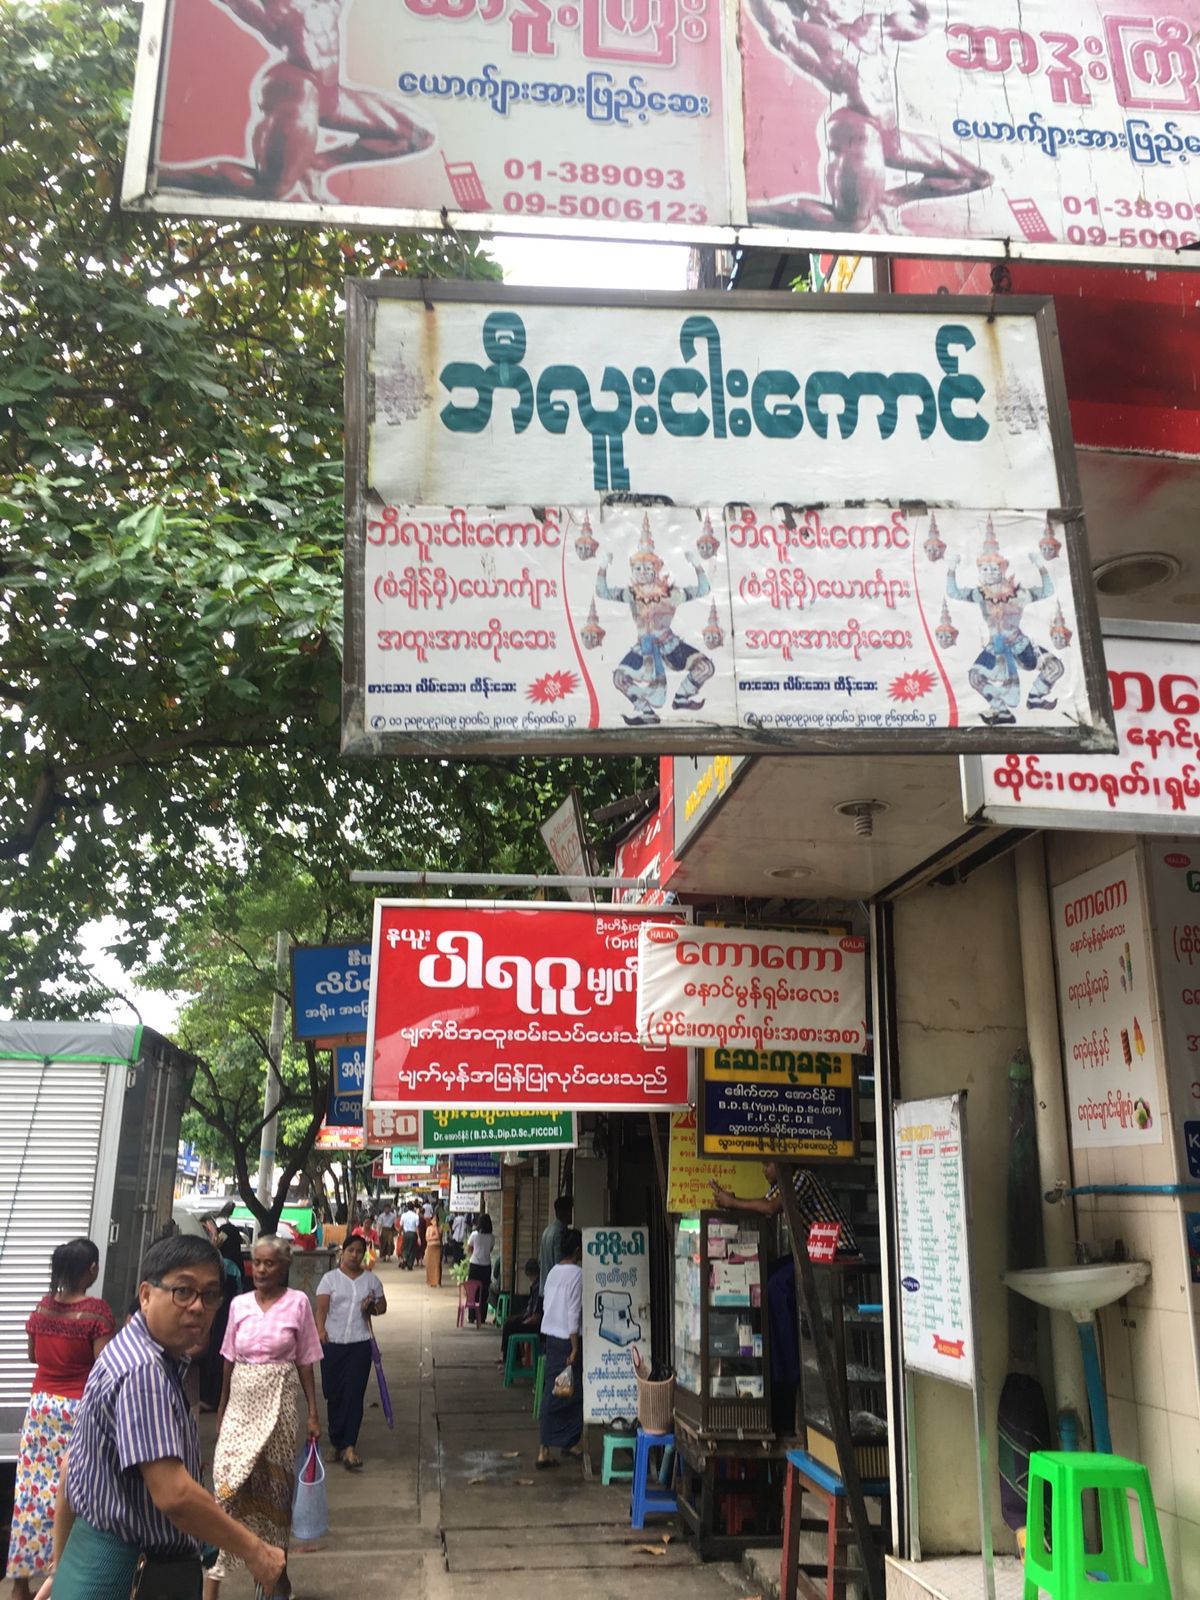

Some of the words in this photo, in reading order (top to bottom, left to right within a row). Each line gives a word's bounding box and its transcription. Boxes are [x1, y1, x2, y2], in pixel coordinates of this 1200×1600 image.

[503, 159, 686, 190] 01-389093
[503, 191, 709, 224] 09-5006123
[439, 311, 990, 491] ဘီလူးငါးကောင်
[367, 507, 560, 562] ဘီလူးငါးကောင်
[729, 510, 910, 563] ဘီလူးငါးကောင်
[377, 618, 557, 662] အထူးအားတိုးဆေး
[1065, 880, 1127, 928] ကောကော
[386, 926, 431, 949] နယူး
[650, 930, 675, 939] HALAL
[418, 930, 593, 1016] ပါရဂူ
[587, 956, 638, 1006] မျက်
[675, 941, 843, 972] ကောကော
[684, 976, 839, 1010] နောင်မွန်ရှမ်းလေး
[400, 1021, 643, 1050] မျက်စိအထူးစမ်းသပ်ပေးသ
[399, 1062, 668, 1094] မျက်မှန်အမြန်ပြုလုပ်ပေးသည်
[714, 1049, 842, 1085] ဆေးကုခနး
